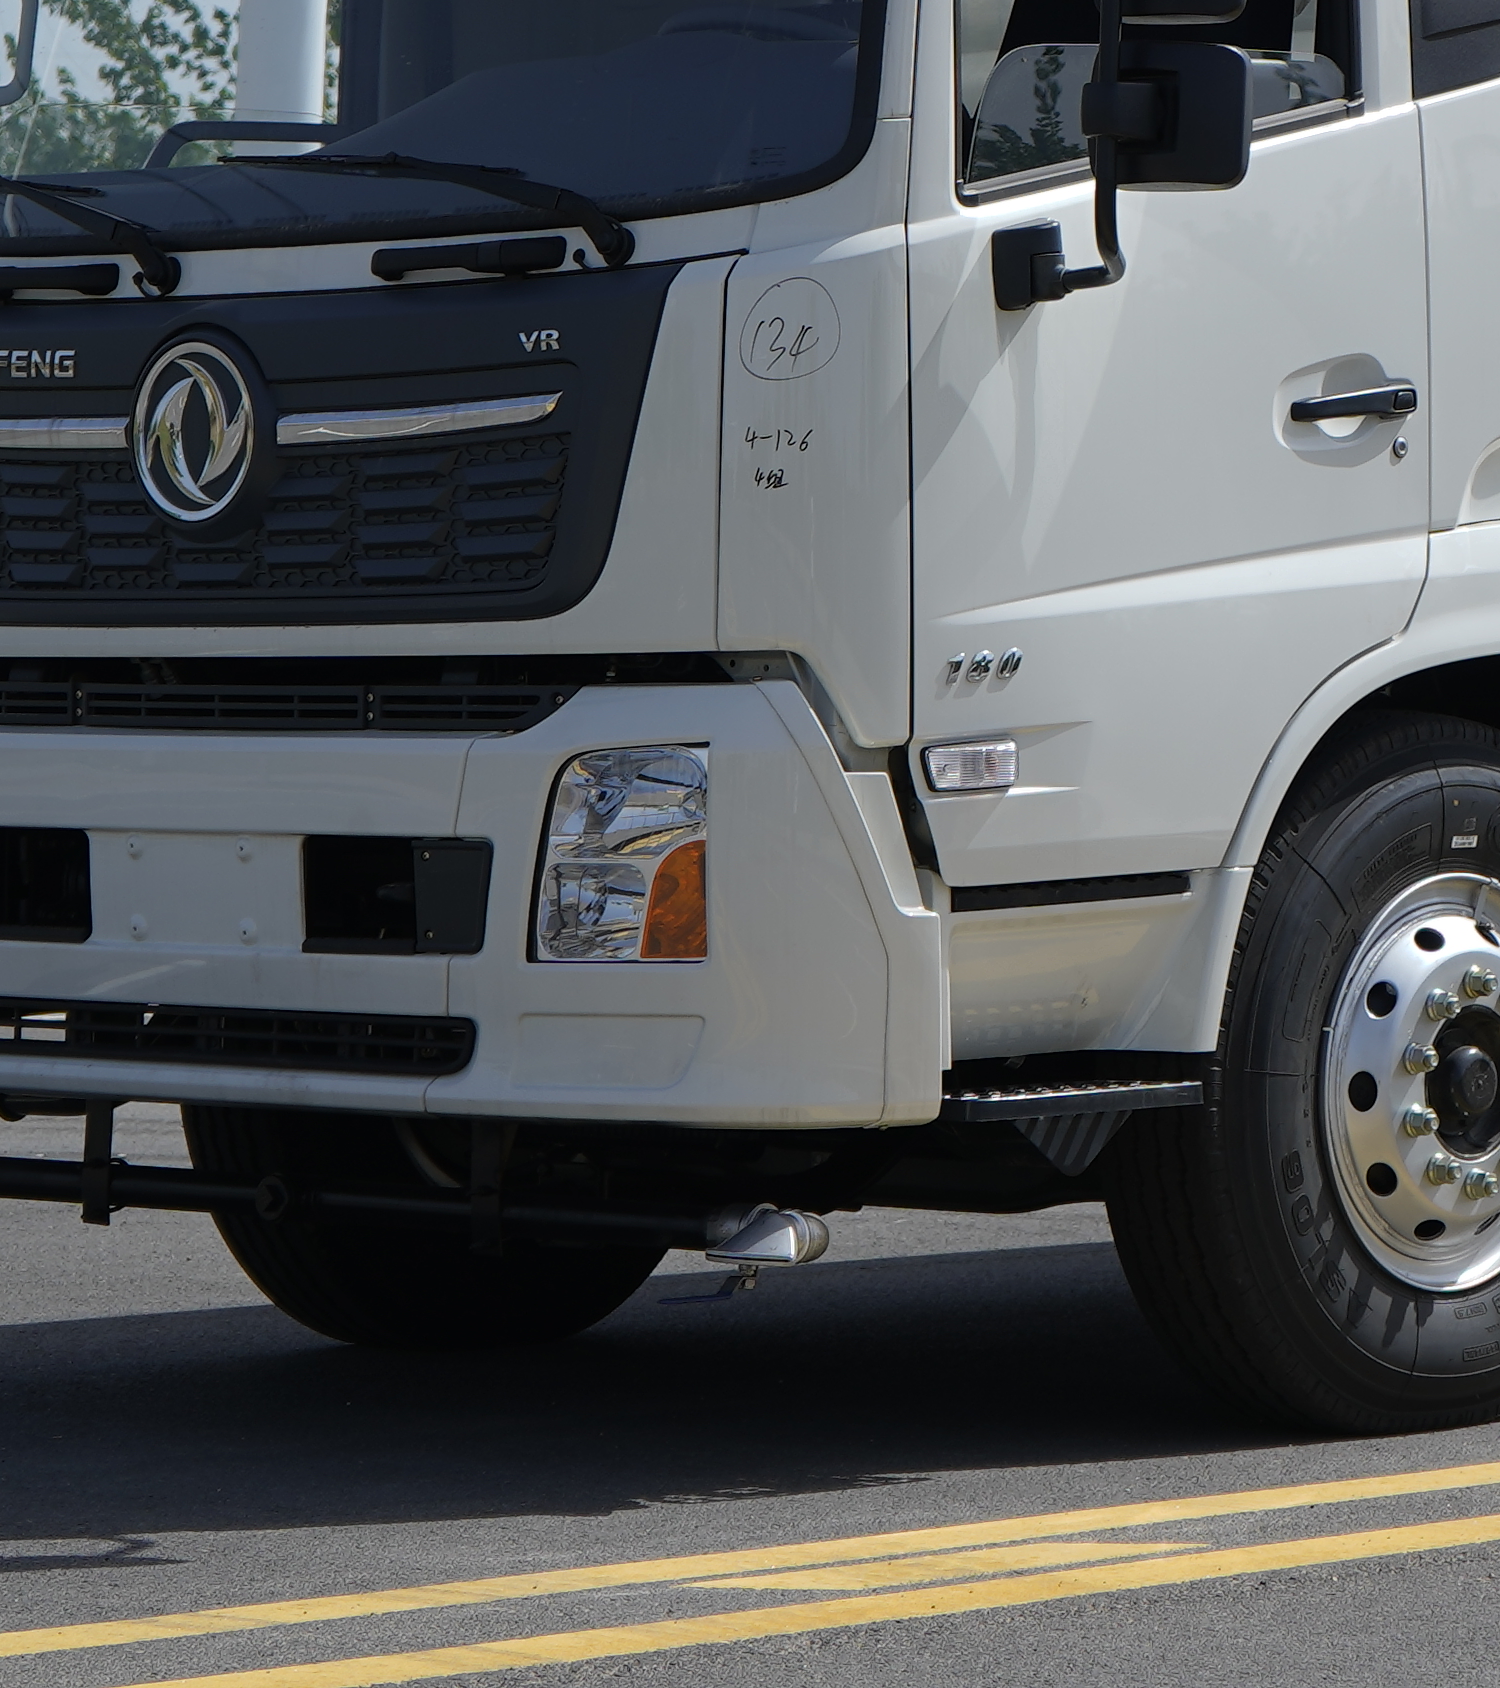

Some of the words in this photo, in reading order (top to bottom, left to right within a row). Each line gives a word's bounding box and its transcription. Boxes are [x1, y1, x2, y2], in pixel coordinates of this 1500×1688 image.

[518, 329, 560, 353] VR
[750, 316, 820, 373] 134
[745, 426, 813, 452] 4-126
[946, 647, 1024, 686] 180
